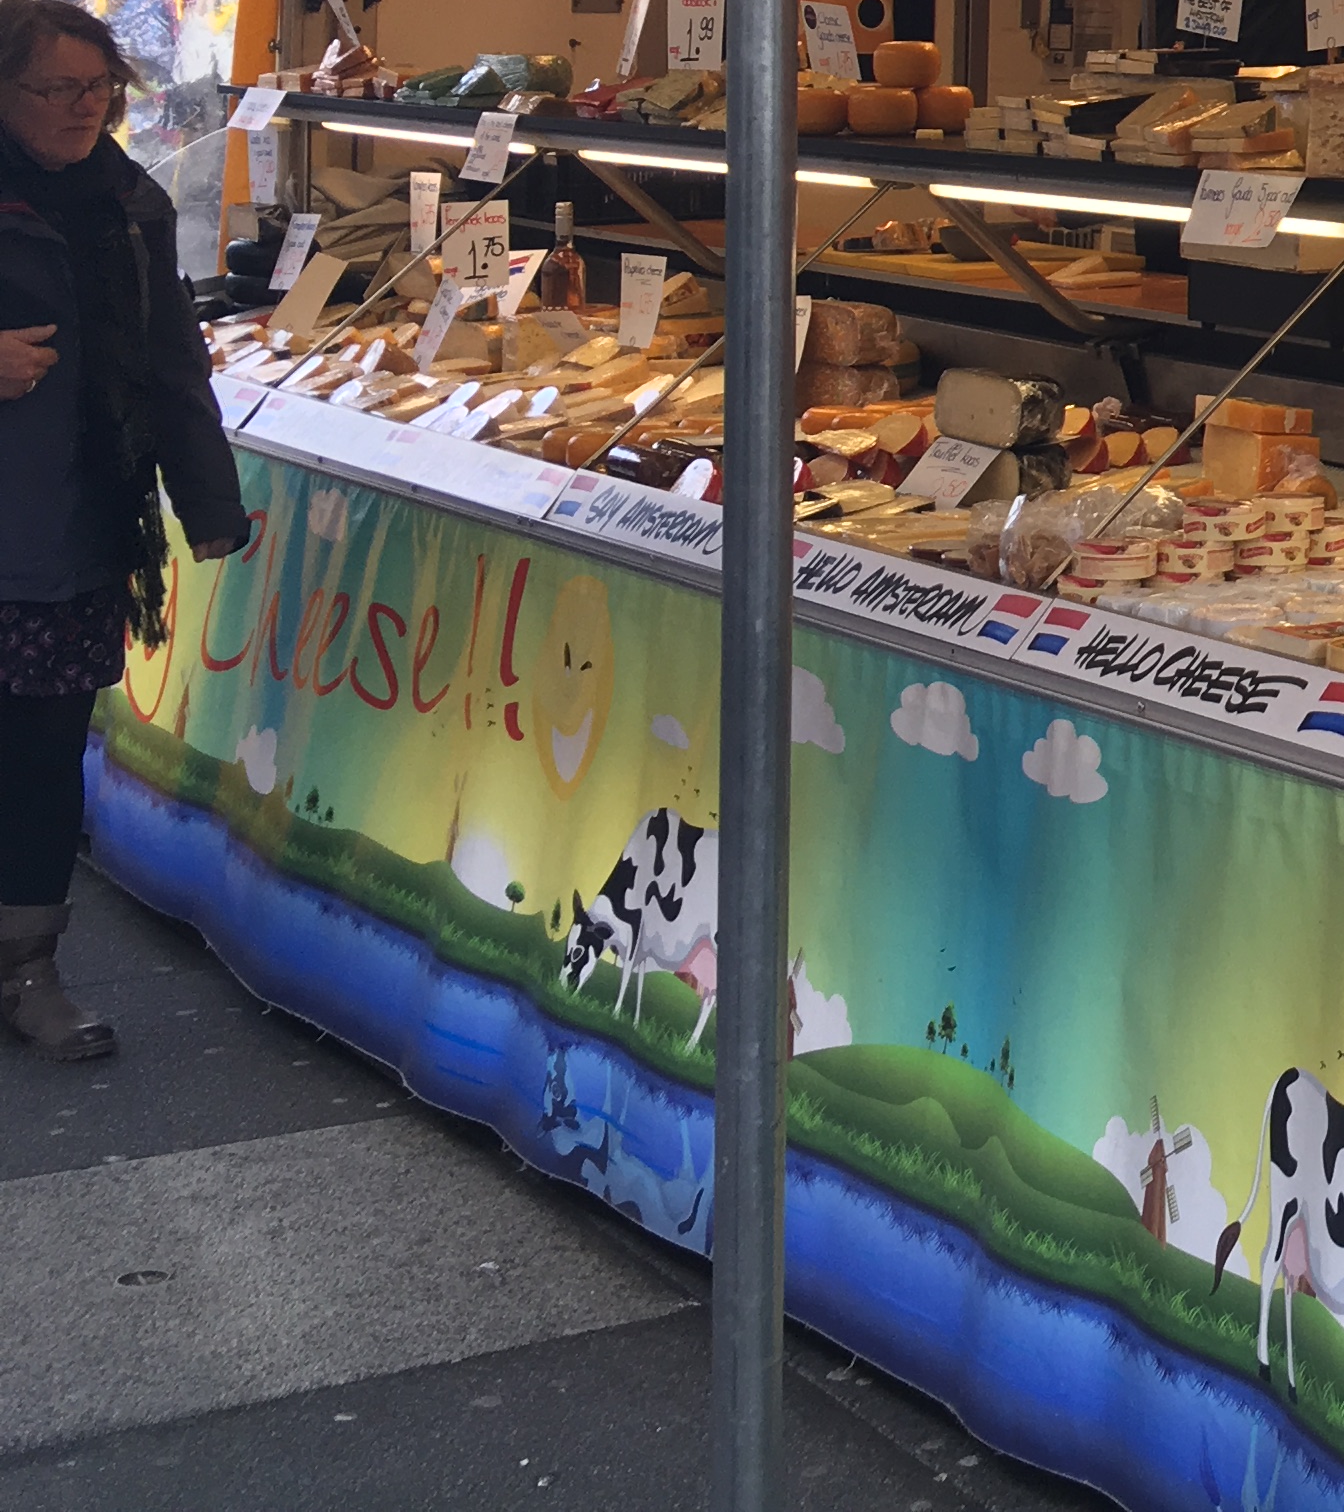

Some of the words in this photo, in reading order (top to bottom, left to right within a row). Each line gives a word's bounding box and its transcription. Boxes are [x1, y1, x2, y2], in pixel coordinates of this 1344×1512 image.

[1221, 0, 1232, 12] OF
[584, 485, 630, 532] SAY
[852, 566, 986, 637] AMSTERDAM
[1074, 623, 1165, 682] HELLO
[1156, 643, 1308, 717] CHEESE
